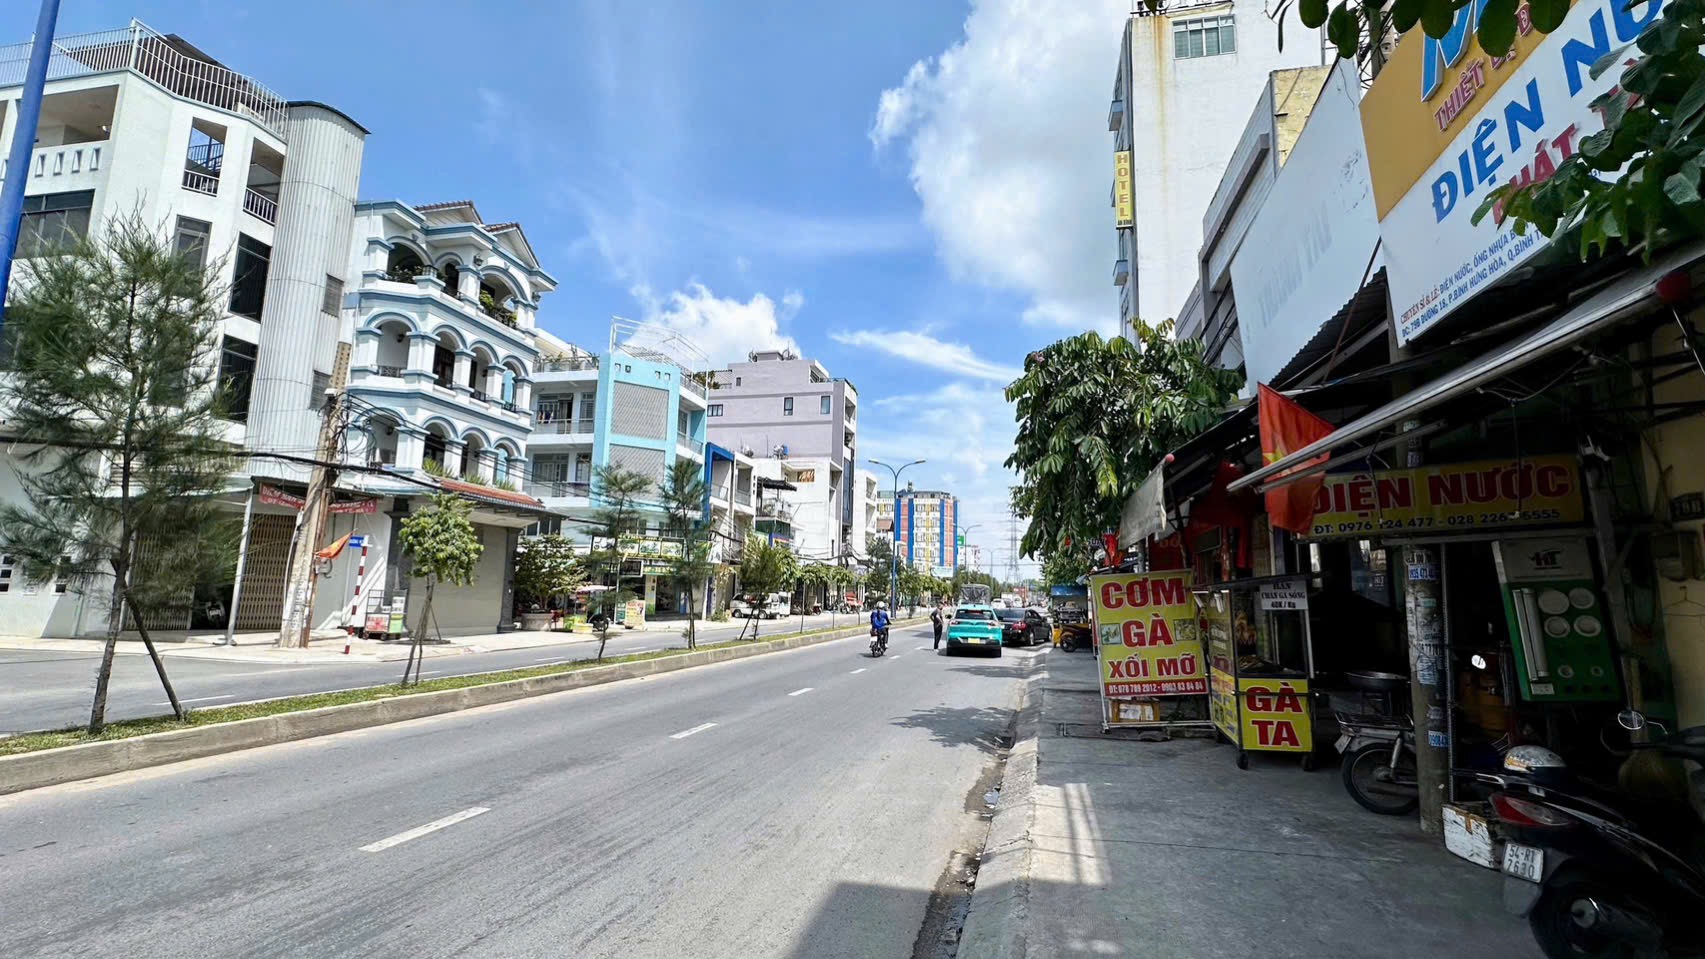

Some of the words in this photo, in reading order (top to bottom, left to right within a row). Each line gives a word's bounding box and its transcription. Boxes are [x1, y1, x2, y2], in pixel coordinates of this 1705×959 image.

[1433, 57, 1485, 132] THIẾT
[1431, 77, 1545, 224] ĐIỆN
[1117, 154, 1128, 217] HOTEL
[1488, 233, 1510, 256] NHỰA
[1506, 237, 1535, 262] Q.BÌNH
[1429, 460, 1570, 506] NƯỚC
[1314, 525, 1335, 535] ĐT:
[1338, 520, 1372, 532] 0976
[1408, 517, 1433, 528] 477
[1447, 514, 1474, 526] 028
[1101, 577, 1187, 609] CƠM
[1122, 612, 1174, 648] GÀ
[1108, 652, 1149, 679] XỐI
[1157, 654, 1197, 677] MỠ
[1246, 680, 1303, 714] GÀ
[1251, 719, 1300, 747] TA
[1506, 858, 1535, 880] 7630
